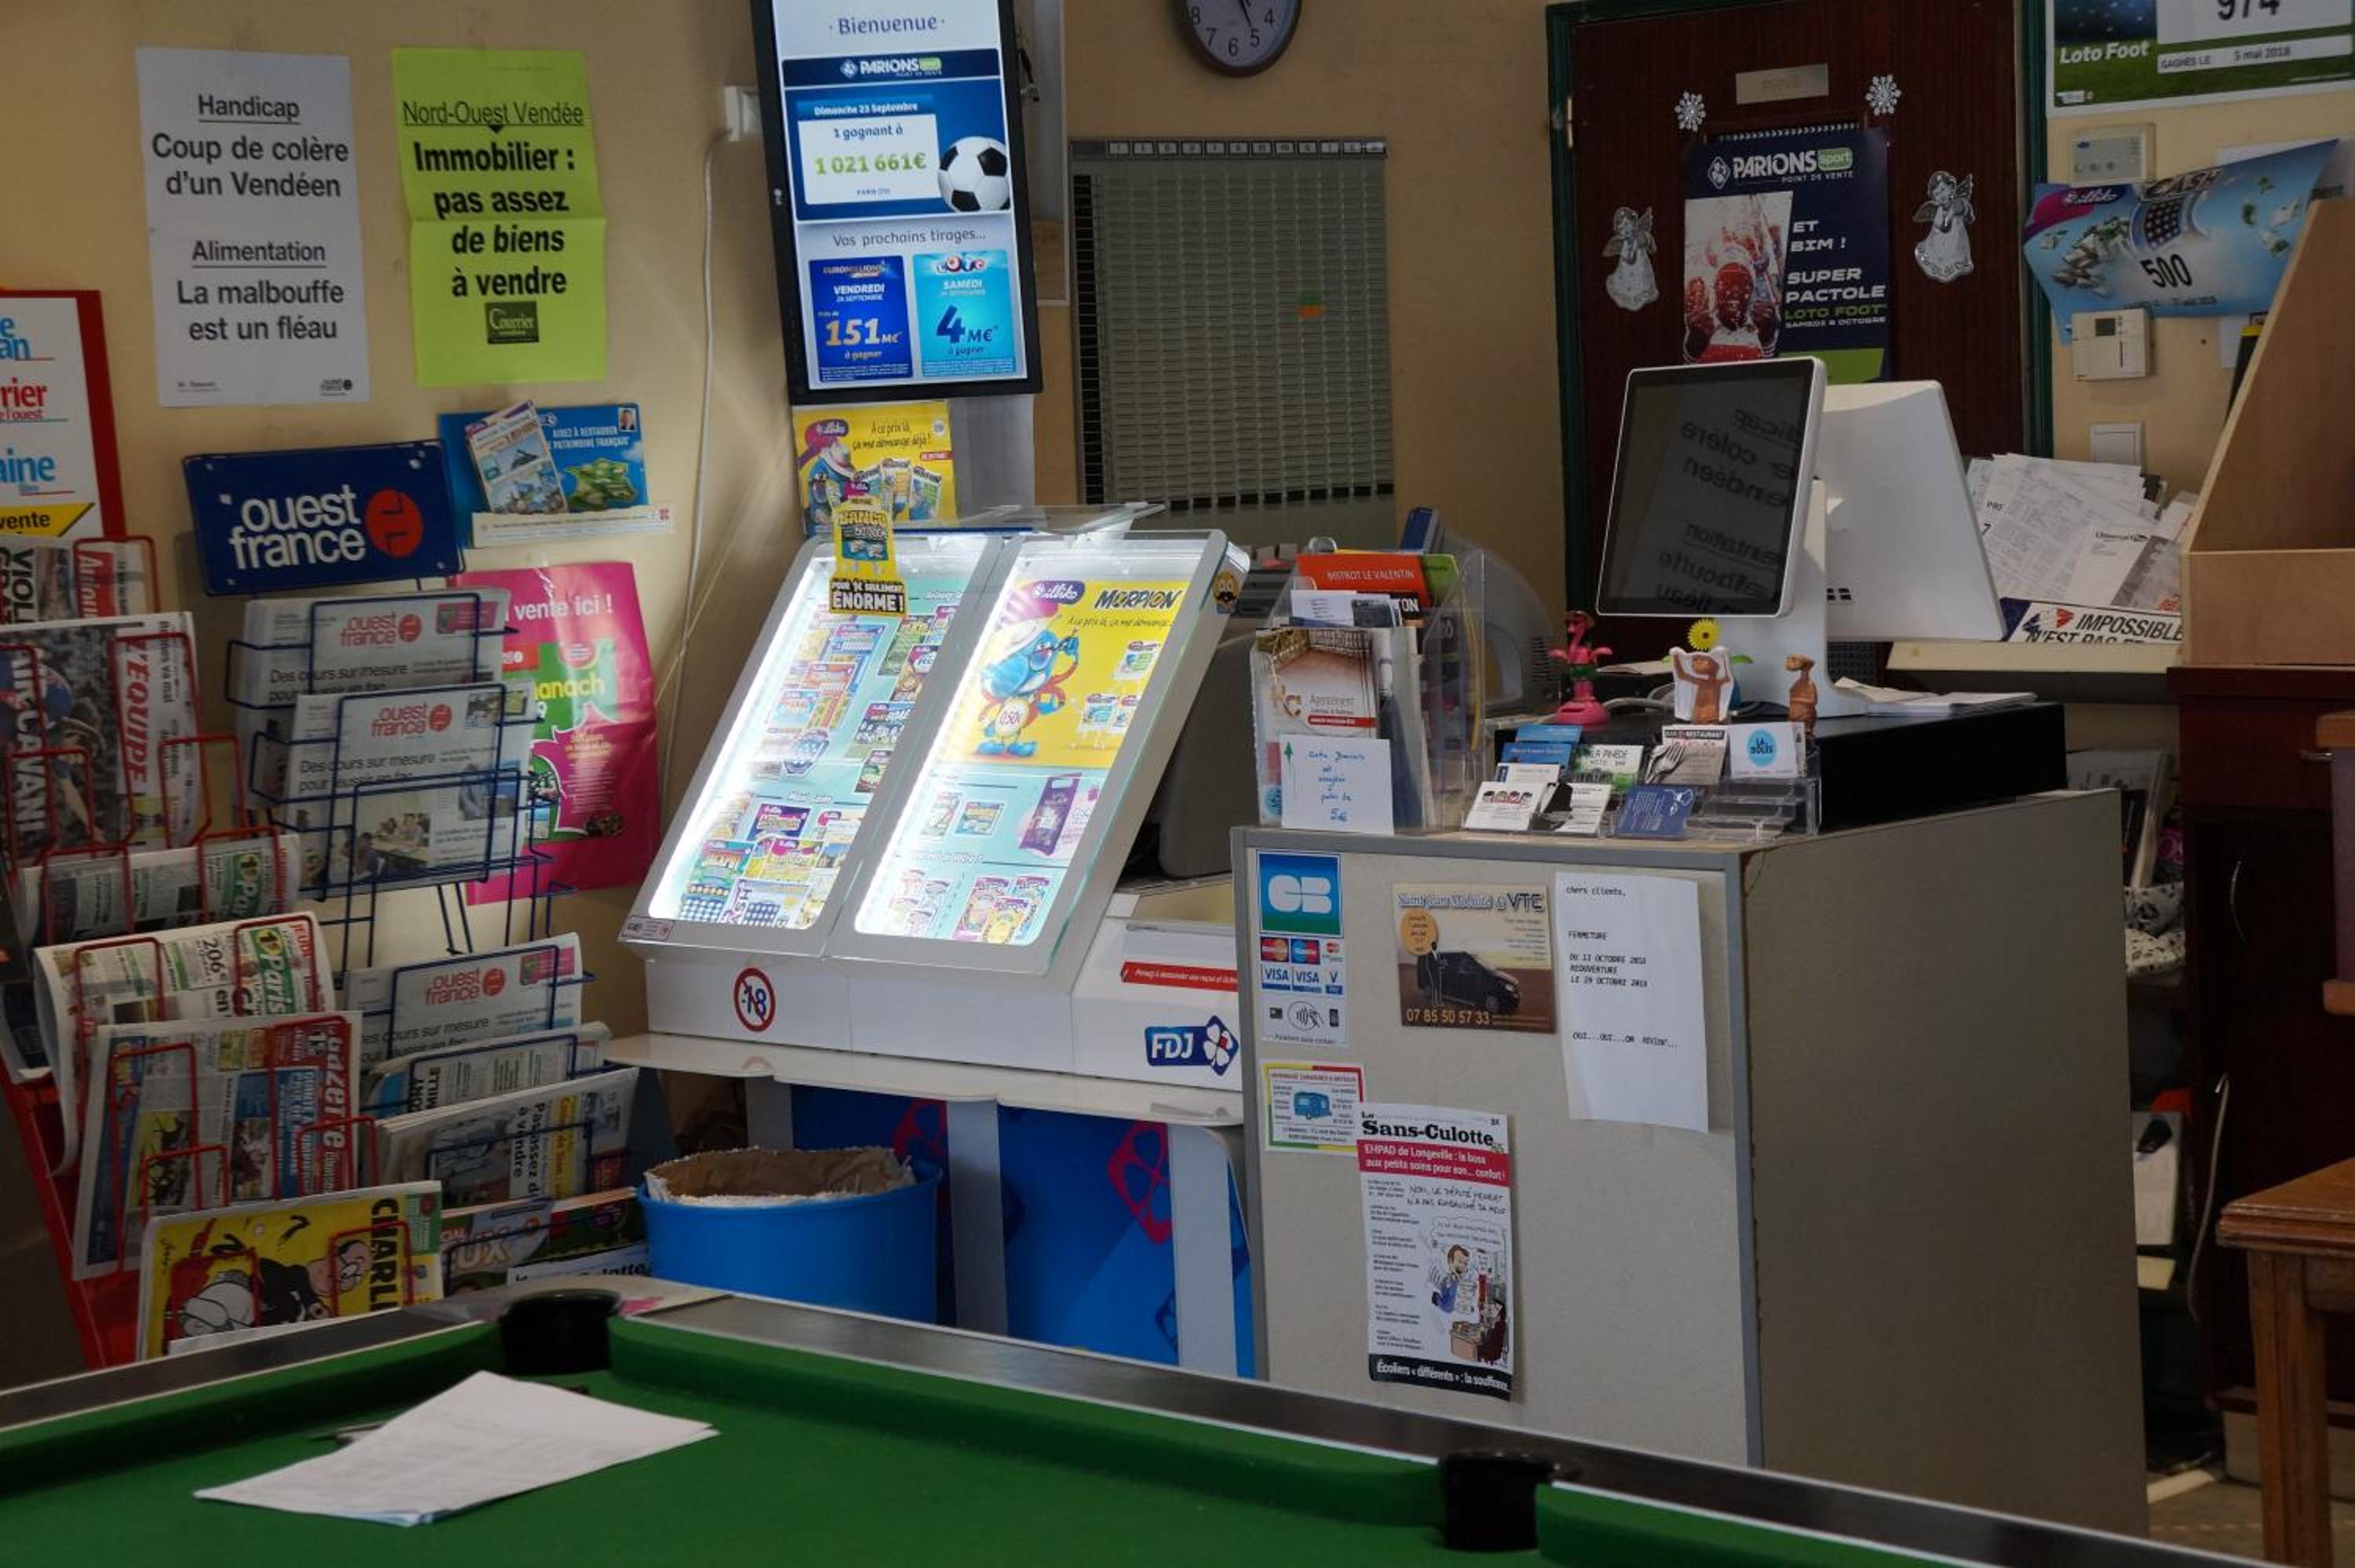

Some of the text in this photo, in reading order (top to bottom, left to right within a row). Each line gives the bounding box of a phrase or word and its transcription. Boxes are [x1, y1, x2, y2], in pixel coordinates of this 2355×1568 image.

[838, 15, 938, 35] Bienvenue
[1264, 10, 1275, 26] 4
[1205, 27, 1218, 47] 7
[1228, 38, 1239, 56] 6
[1251, 28, 1261, 48] 5
[2059, 40, 2149, 64] Loto Foot
[197, 93, 301, 122] Handicap
[403, 101, 584, 125] Nord-Ouest Vendée
[871, 101, 918, 115] Septembre
[843, 125, 893, 141] gagnant
[152, 133, 349, 164] Coup de colère
[414, 142, 558, 171] Immobilier
[1733, 151, 1817, 180] PARIONS
[166, 170, 341, 198] d'un Vendéen
[433, 189, 570, 220] pas assez
[1792, 220, 1819, 234] ET
[451, 225, 565, 254] de biens
[833, 234, 857, 248] Vos
[862, 229, 926, 249] prochains
[1791, 238, 1834, 252] BIM
[192, 240, 327, 262] Alimentation
[451, 265, 566, 297] à vendre
[1787, 267, 1862, 285] SUPER
[2141, 253, 2193, 289] 500
[177, 279, 345, 305] La malbouffe
[833, 283, 885, 296] VENDREDI
[943, 279, 983, 290] SAMEDI
[1785, 285, 1886, 304] PACTOLE
[936, 304, 966, 345] 4
[1784, 307, 1831, 321] LOTO
[188, 315, 338, 341] est un fléau
[826, 316, 881, 348] 151
[241, 484, 363, 534] ouest
[228, 527, 367, 571] france
[515, 600, 568, 621] vente
[575, 595, 599, 615] ici
[1094, 589, 1183, 611] MORPION
[348, 612, 396, 630] ouest
[340, 628, 396, 647] france
[378, 702, 427, 722] ouest
[371, 720, 427, 737] france
[1267, 873, 1333, 914] CB
[263, 954, 291, 1015] Paris
[433, 967, 480, 990] ouest
[1265, 968, 1290, 981] VISA
[1295, 971, 1320, 983] VISA
[425, 986, 480, 1005] france
[1406, 1008, 1421, 1023] 07
[1151, 1031, 1194, 1059] FDJ
[1361, 1120, 1494, 1147] Sans-Culotte
[1364, 1143, 1396, 1155] EHPAD
[1398, 1146, 1409, 1156] de
[1411, 1148, 1453, 1162] Longeville
[1366, 1158, 1382, 1168] aux
